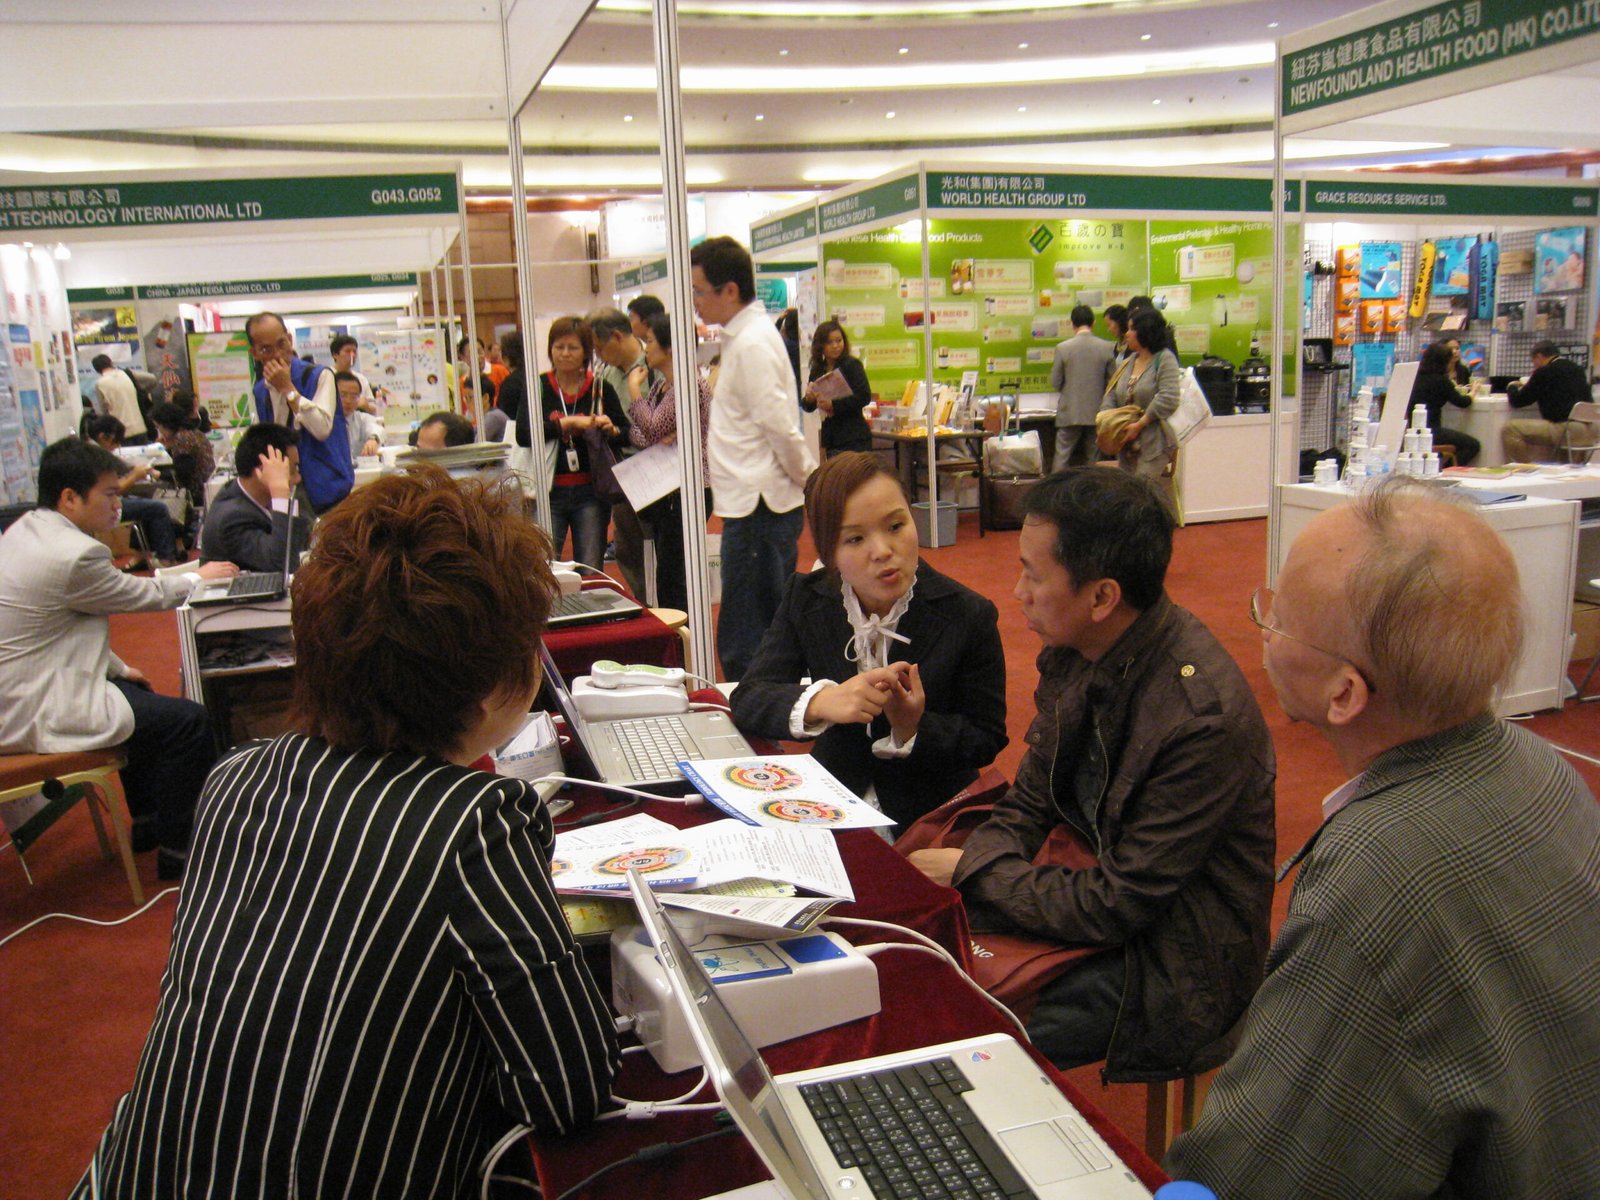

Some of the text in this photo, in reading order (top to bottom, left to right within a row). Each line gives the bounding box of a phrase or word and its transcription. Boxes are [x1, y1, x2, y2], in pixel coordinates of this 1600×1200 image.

[1290, 61, 1394, 107] NEWFOUNDLAND
[1396, 42, 1452, 78] HEALTH
[1454, 30, 1499, 62] FOOD
[1502, 17, 1537, 54] (HK)
[941, 177, 1045, 191] 光和(集團)有限公司
[371, 186, 442, 205] G043.G052
[941, 192, 1087, 206] WORLD HEALTH GROUP LTD
[1315, 191, 1448, 206] GRACE RESOURCE SERVICE LTD.
[11, 207, 117, 226] TECHNOLOGY
[121, 203, 234, 223] INTERNATIONAL
[237, 202, 263, 218] LTD
[870, 232, 899, 242] Health
[928, 233, 945, 242] ood
[946, 232, 983, 242] Products
[146, 288, 168, 299] CHINA
[176, 286, 199, 297] JAPAN
[225, 284, 250, 295] UNION
[268, 283, 281, 292] LTD
